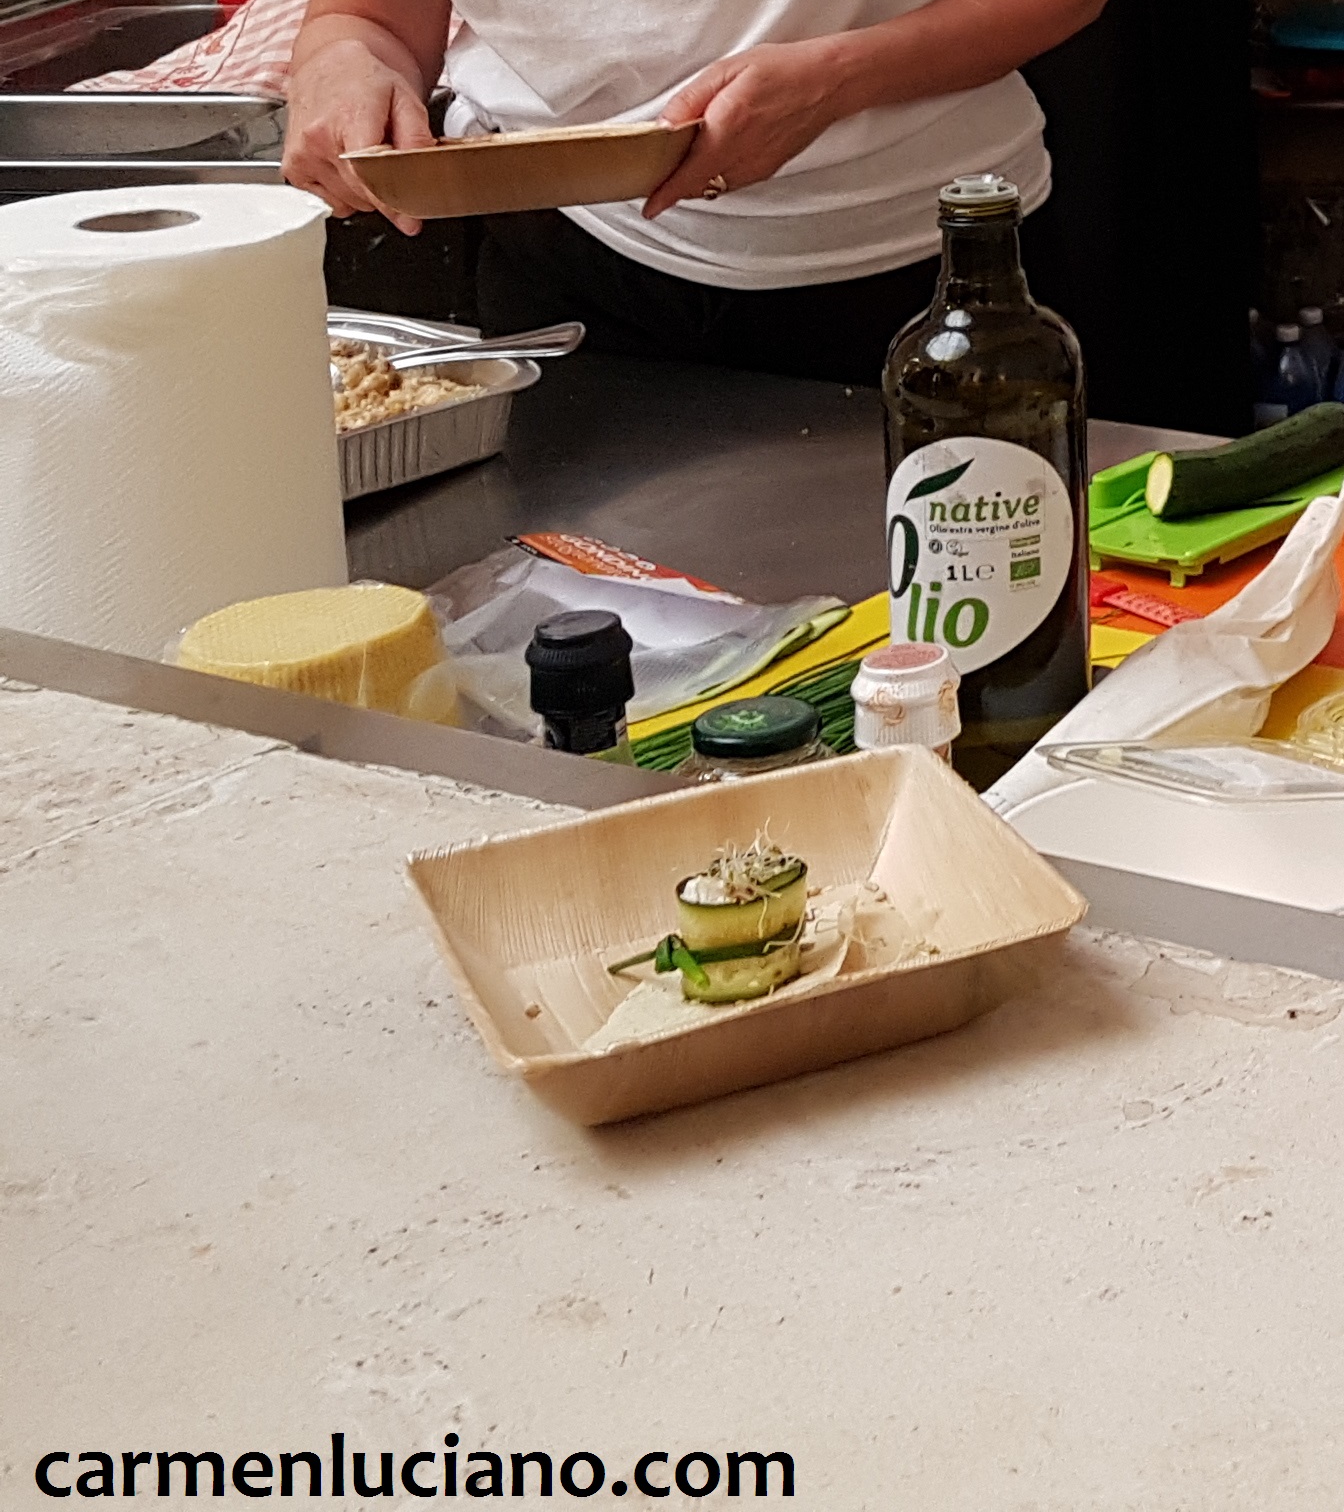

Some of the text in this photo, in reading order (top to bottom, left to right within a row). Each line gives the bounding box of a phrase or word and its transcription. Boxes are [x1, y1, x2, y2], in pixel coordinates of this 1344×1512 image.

[929, 491, 1040, 523] native
[929, 524, 948, 534] Olio
[949, 526, 973, 534] extra
[975, 524, 1010, 535] vergine
